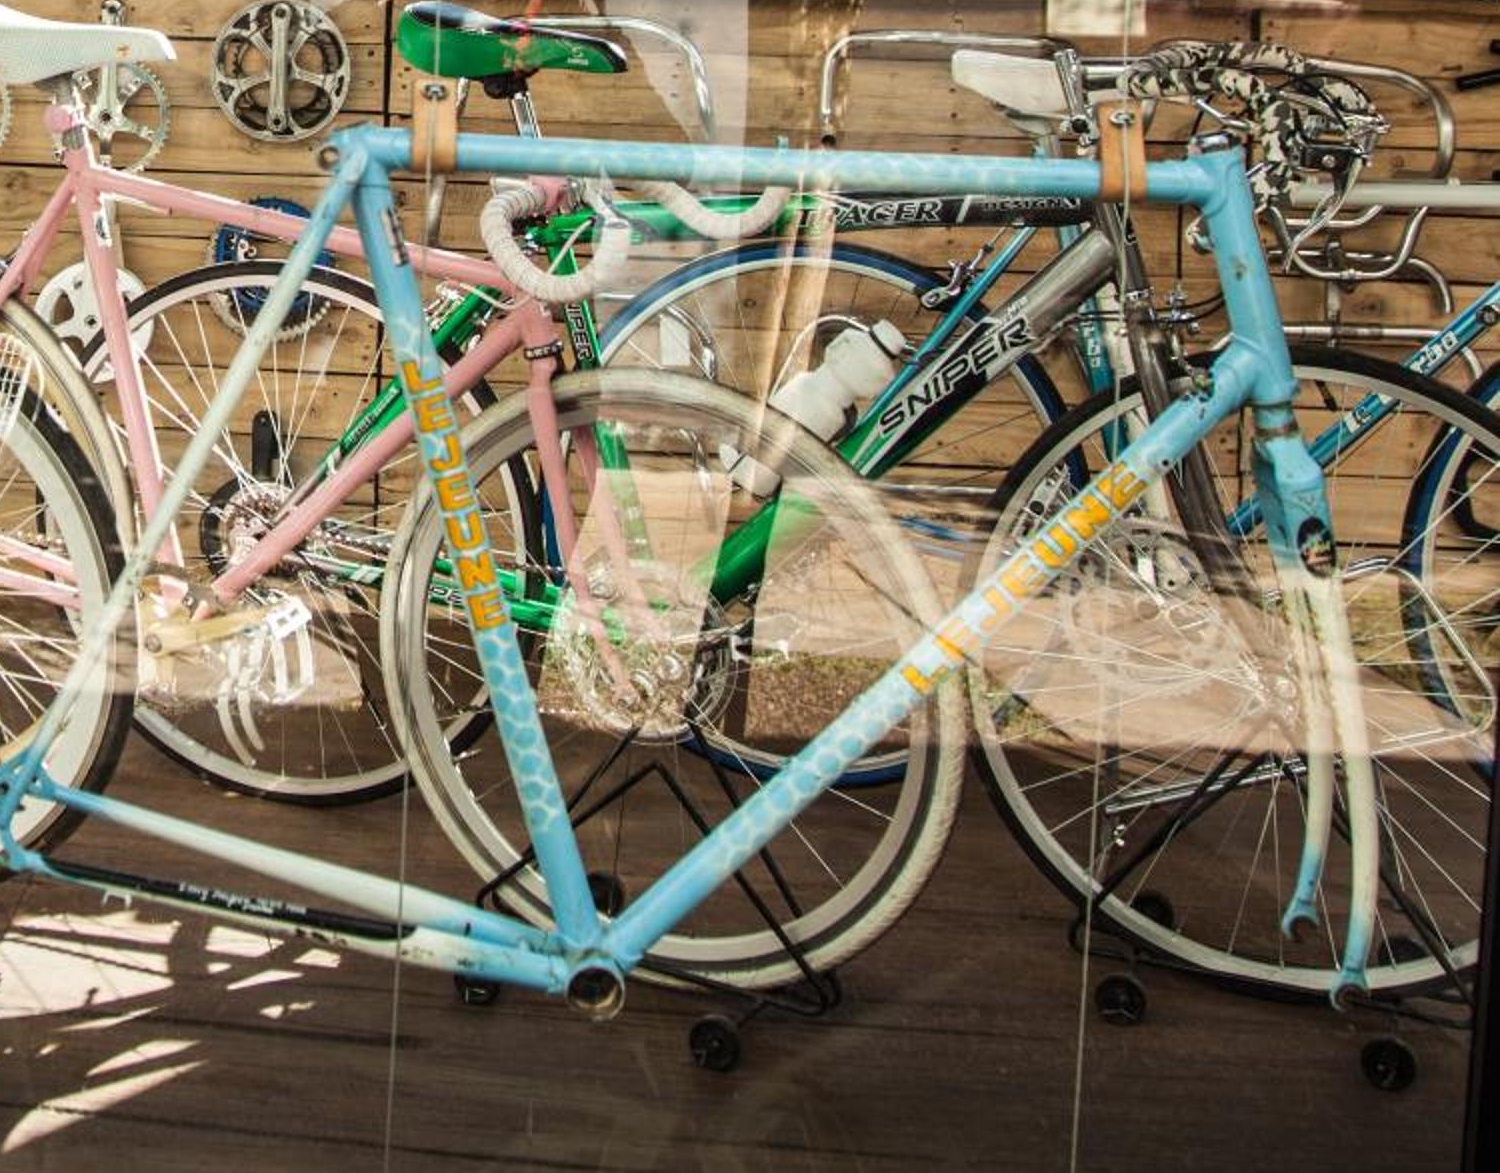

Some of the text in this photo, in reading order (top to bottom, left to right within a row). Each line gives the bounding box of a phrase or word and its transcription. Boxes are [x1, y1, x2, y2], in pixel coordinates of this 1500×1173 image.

[878, 313, 1038, 438] SNIPER
[402, 360, 509, 631] LEJEUNE
[901, 460, 1148, 694] LEJEUNE
